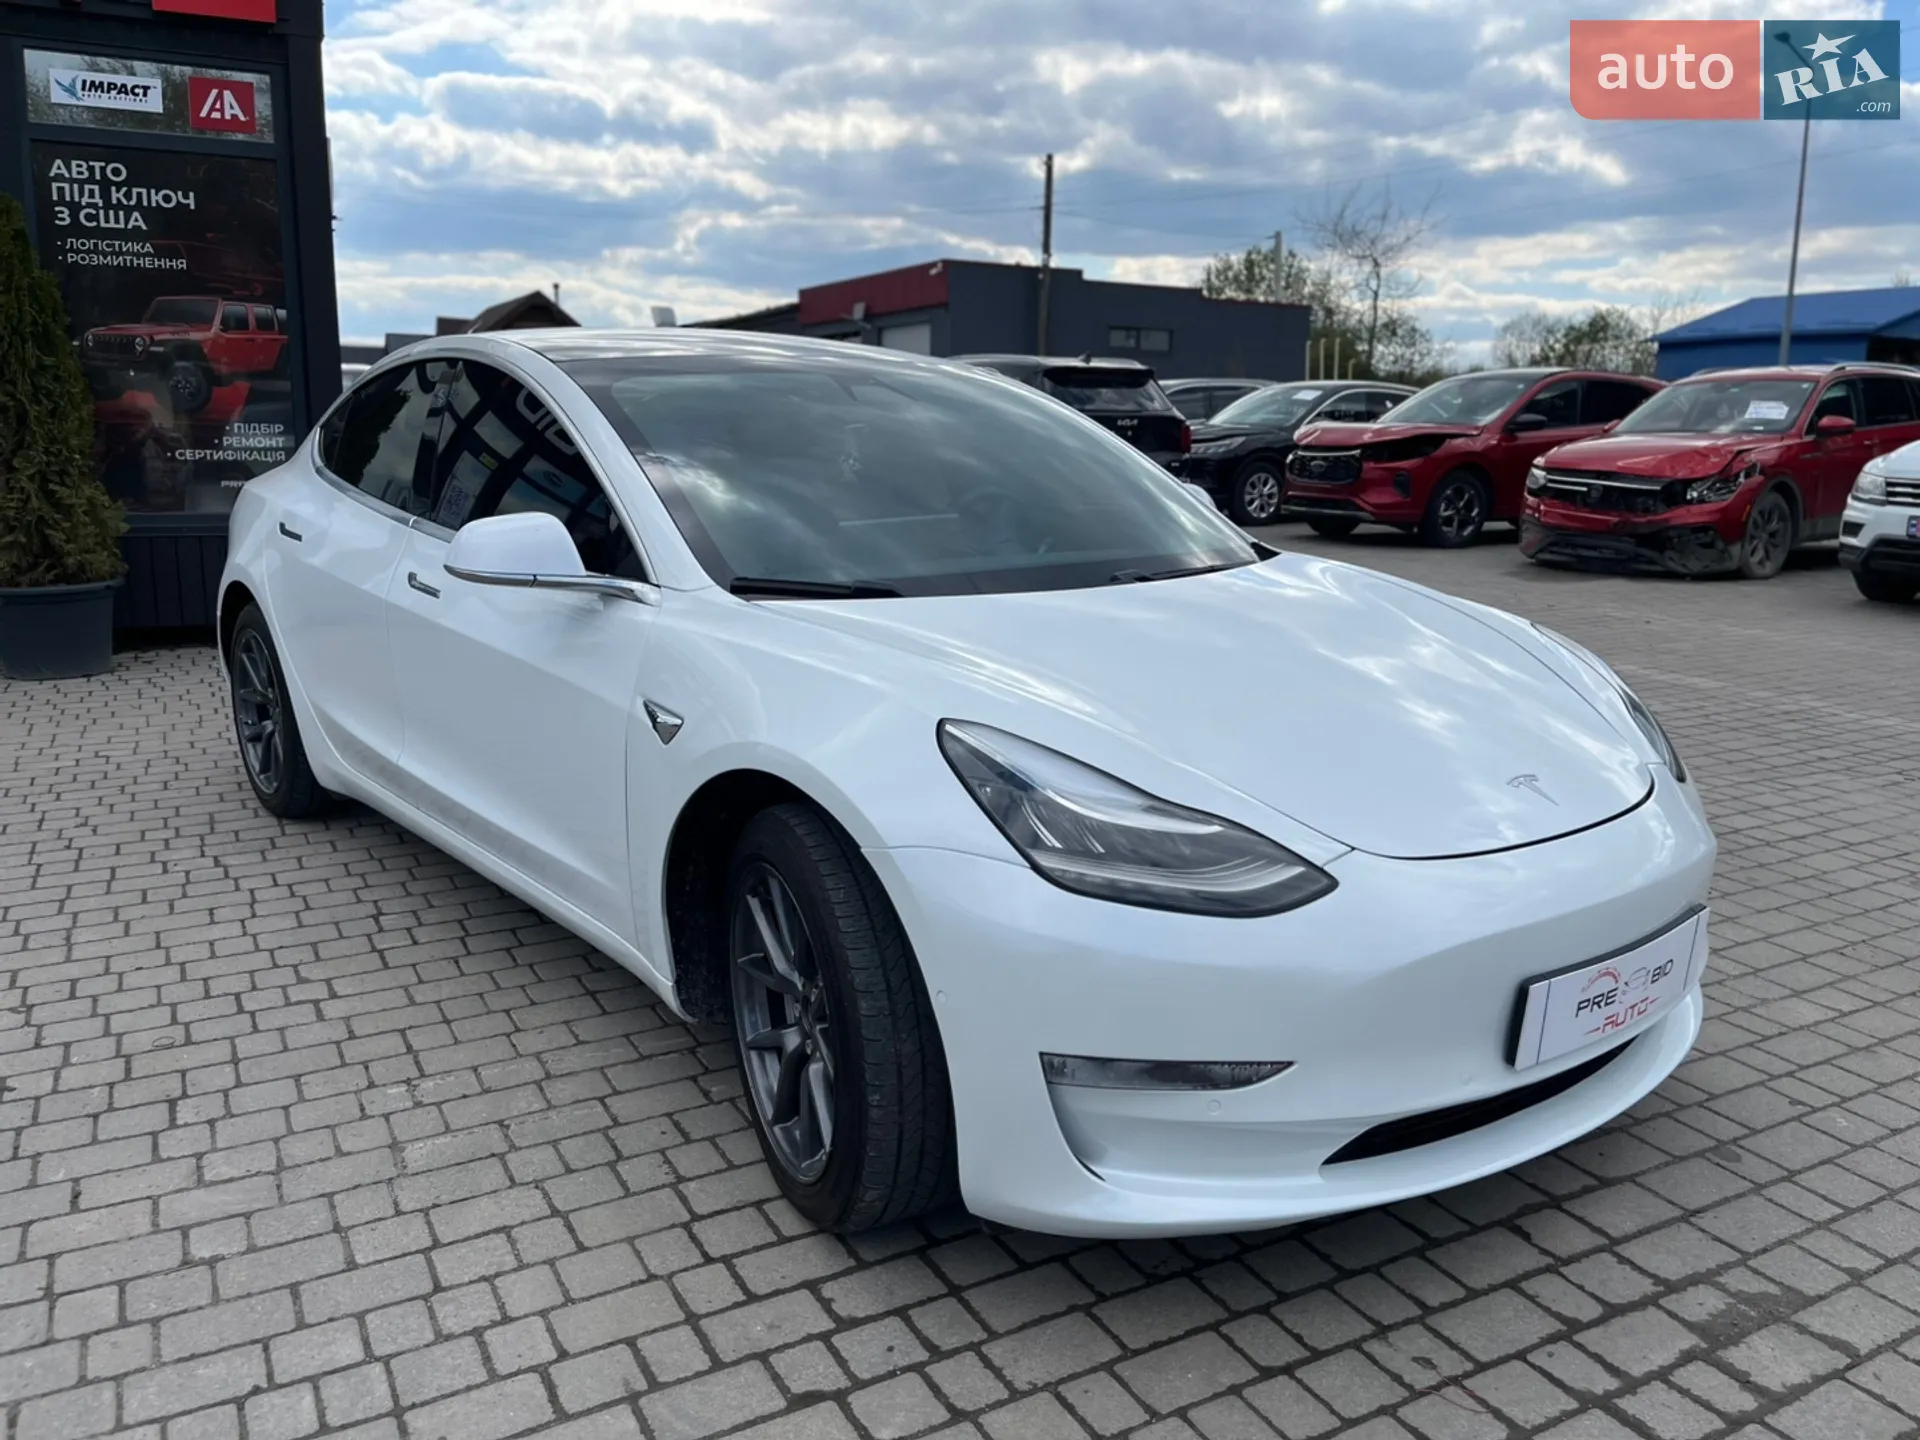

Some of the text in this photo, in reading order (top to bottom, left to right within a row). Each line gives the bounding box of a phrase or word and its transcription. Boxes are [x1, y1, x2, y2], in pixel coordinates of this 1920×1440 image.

[81, 78, 151, 98] IMPACT
[49, 158, 127, 182] АВТО
[51, 182, 195, 210] ПІД КЛЮЧ
[54, 206, 148, 230] З США
[65, 238, 155, 254] ЛОГІСТИКА
[67, 253, 187, 270] РОЗМИТНЕННЯ
[233, 423, 284, 435] ПІДБІР
[222, 436, 284, 448] РЕМОНТ
[175, 449, 286, 462] СЕРТИФІКАЦІЯ
[1575, 958, 1674, 1018] PRE BID
[1601, 996, 1650, 1034] AUTO
